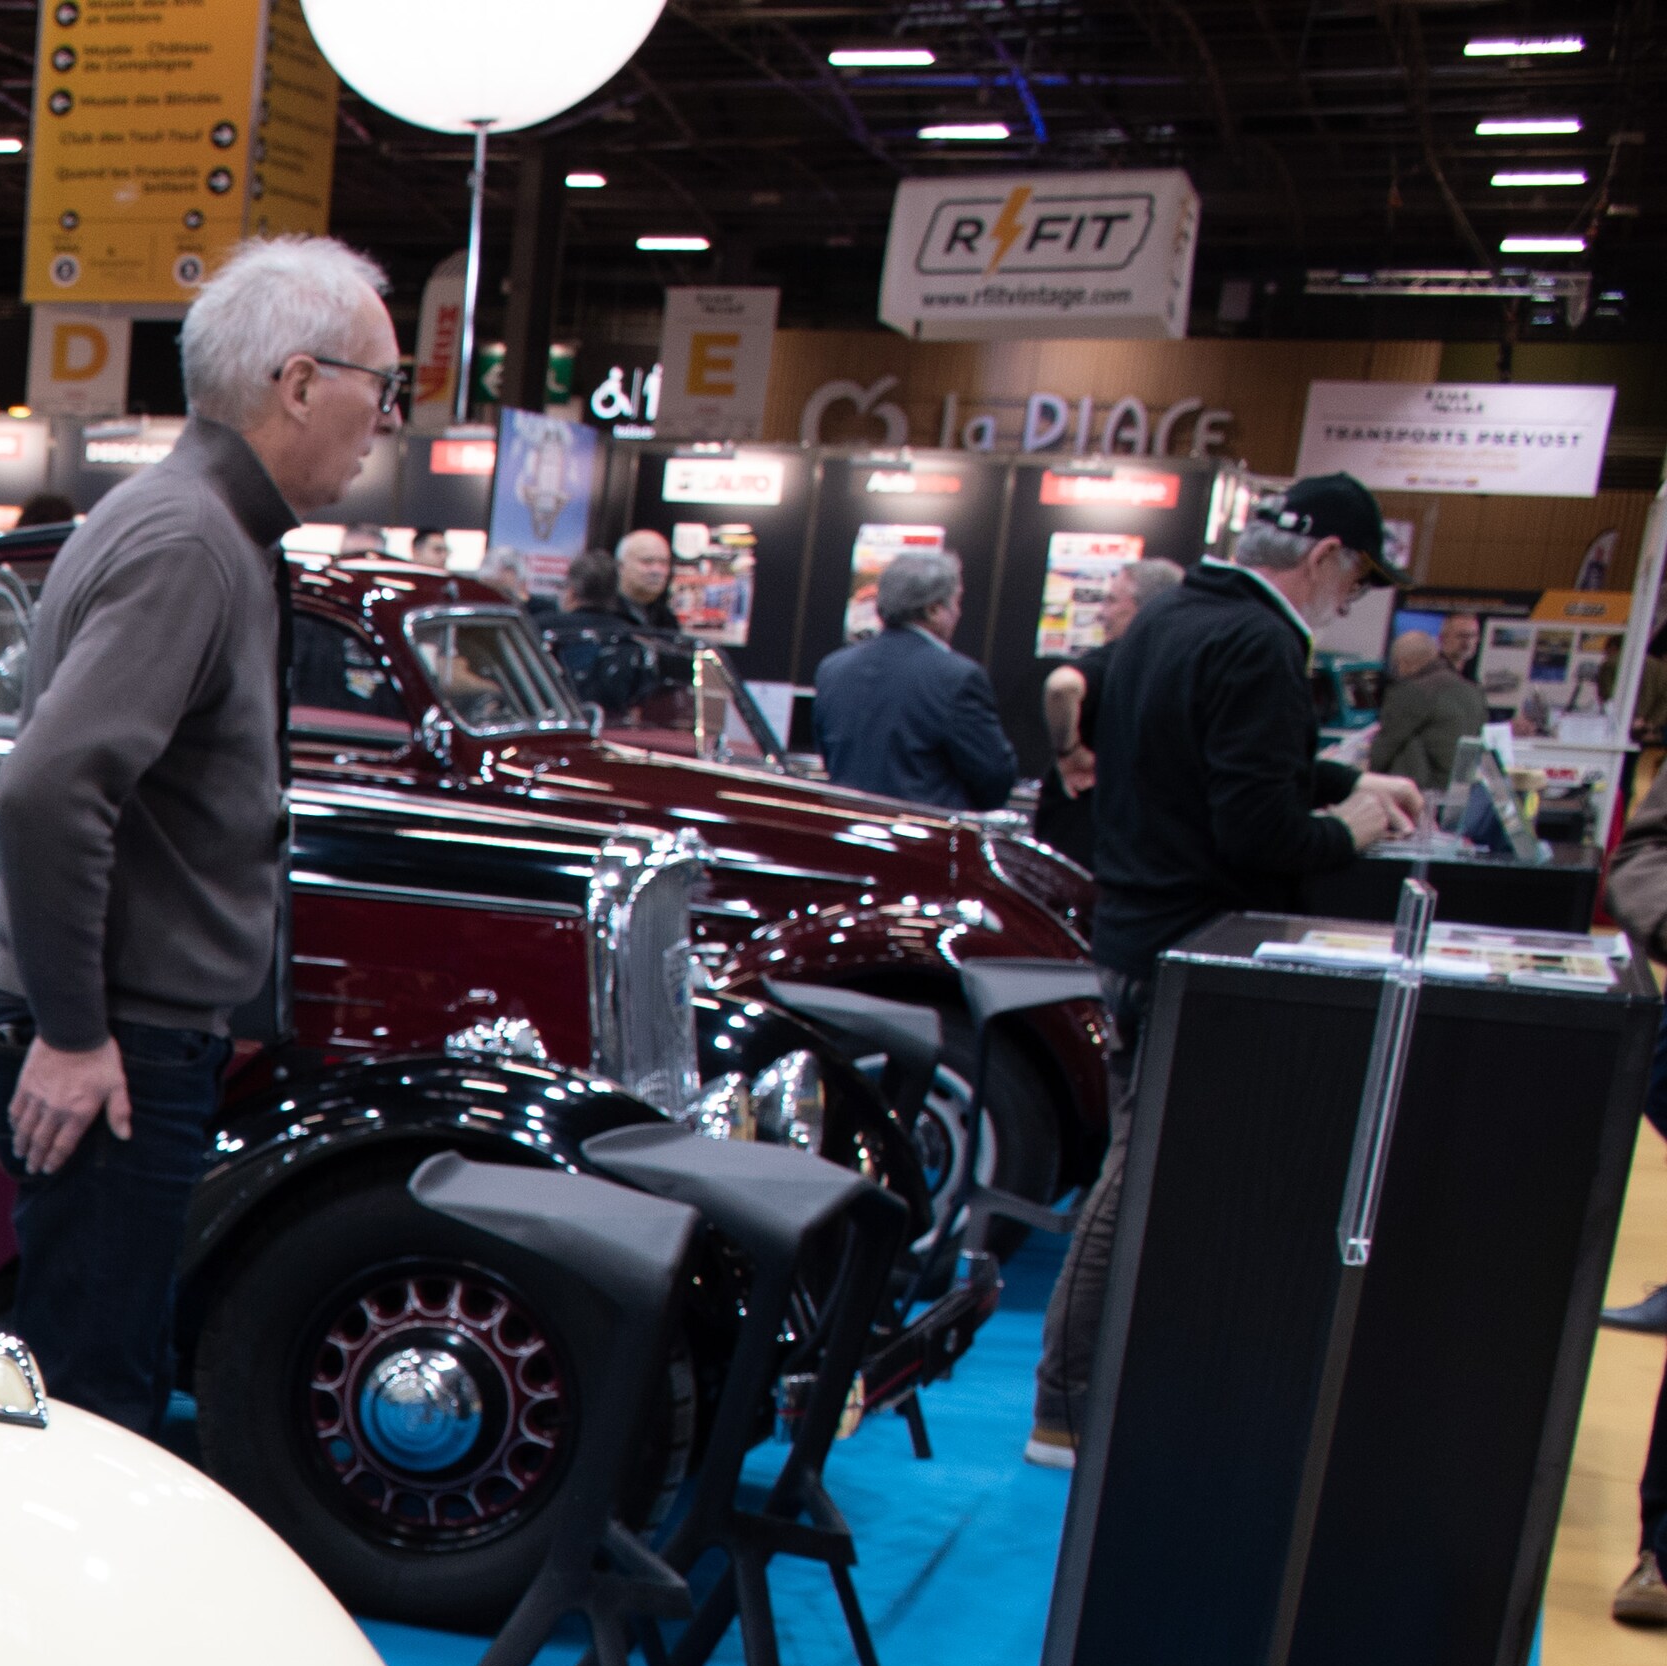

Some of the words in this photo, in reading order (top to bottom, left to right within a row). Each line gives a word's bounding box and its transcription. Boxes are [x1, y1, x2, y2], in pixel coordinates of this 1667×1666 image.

[51, 322, 110, 382] D
[685, 331, 741, 397] E
[1324, 424, 1469, 446] TRANSPORTS
